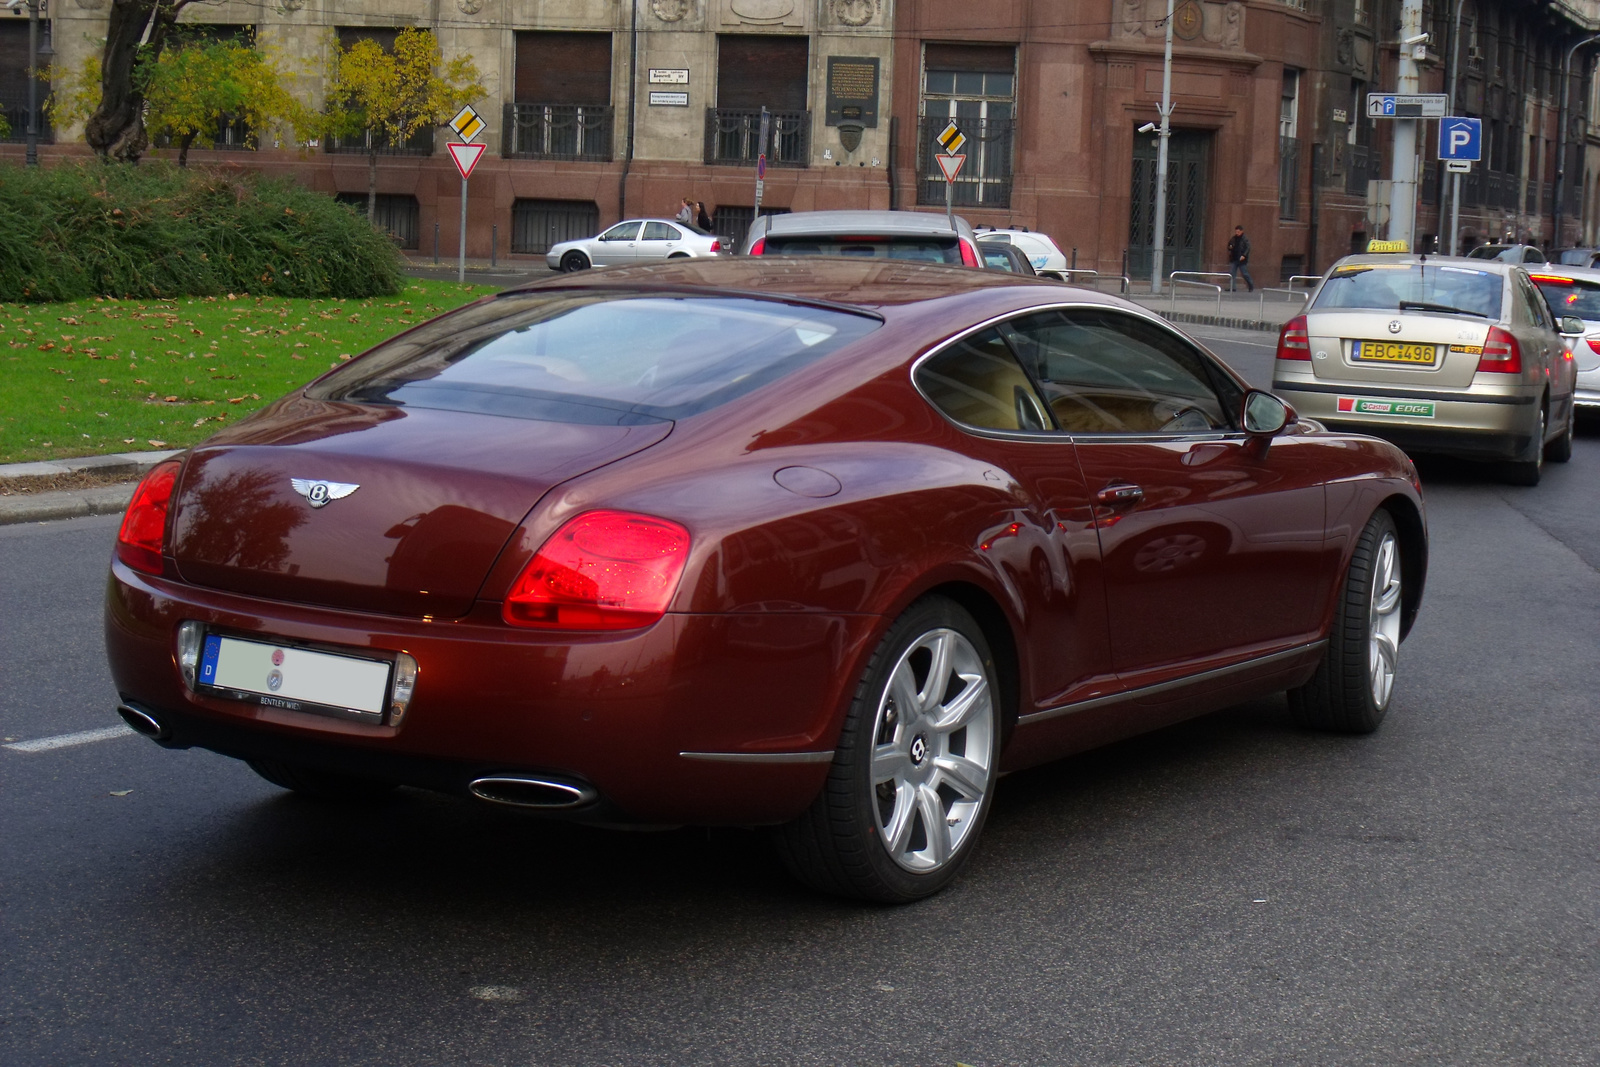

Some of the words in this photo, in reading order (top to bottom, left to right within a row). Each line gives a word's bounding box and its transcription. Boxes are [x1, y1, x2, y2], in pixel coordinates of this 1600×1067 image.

[1386, 103, 1393, 113] P
[1449, 130, 1471, 155] P
[1367, 403, 1390, 411] Castrol
[1395, 404, 1430, 413] EDGE
[205, 664, 212, 676] D
[260, 696, 286, 708] BENTLEY
